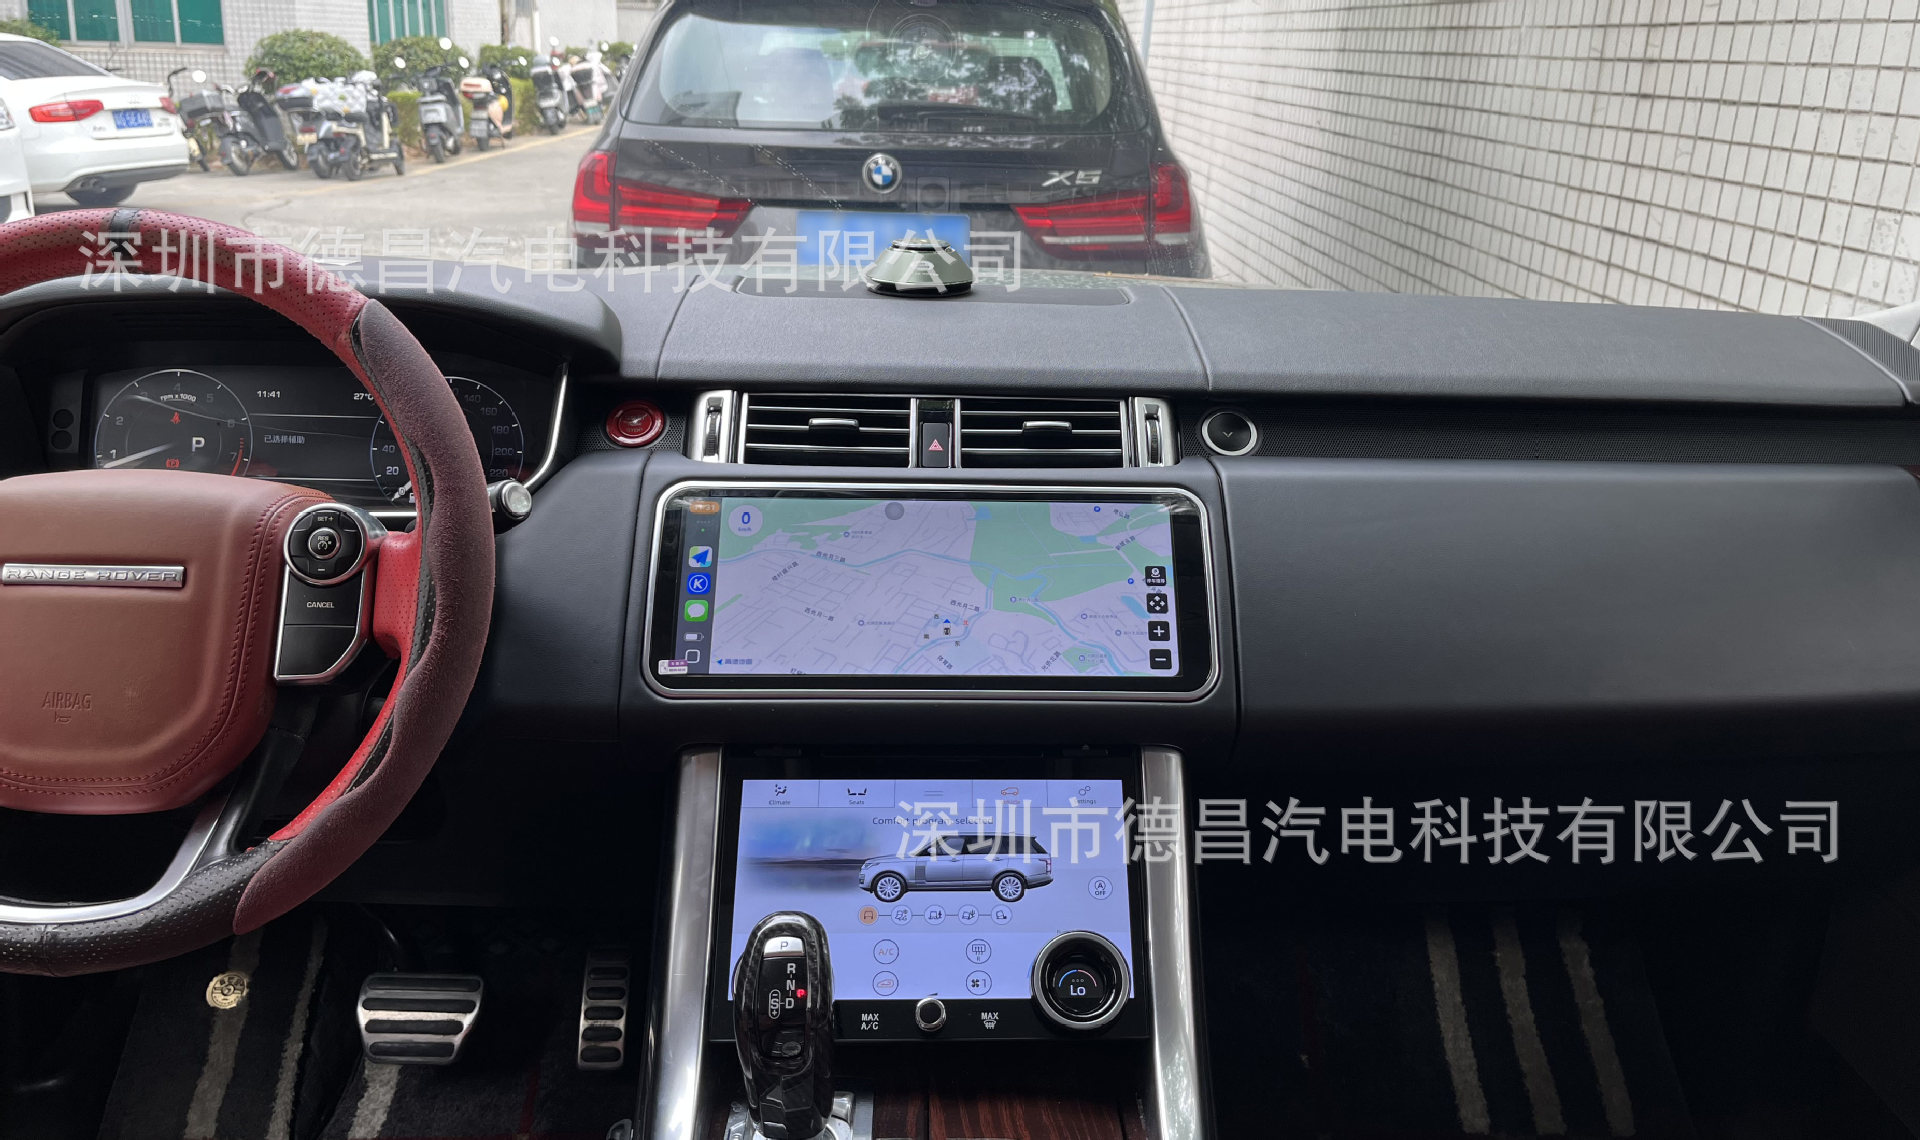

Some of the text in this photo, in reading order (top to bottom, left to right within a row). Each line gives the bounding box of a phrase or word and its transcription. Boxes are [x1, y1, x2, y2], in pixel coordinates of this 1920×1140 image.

[1042, 169, 1102, 187] X5
[173, 382, 181, 392] 4
[160, 394, 174, 402] rpm
[179, 393, 197, 402] 1000
[206, 393, 214, 403] 5
[256, 390, 281, 398] 11:41
[463, 394, 481, 403] 140
[480, 407, 498, 417] 160
[115, 415, 124, 426] 2
[227, 418, 236, 428] 6
[491, 425, 510, 435] 180
[192, 436, 205, 452] P
[382, 444, 396, 454] 40
[109, 449, 117, 459] 1
[229, 451, 238, 462] 7
[494, 447, 514, 457] 200
[386, 466, 399, 476] 20
[489, 468, 509, 478] 220
[741, 511, 751, 525] 0
[6, 567, 178, 583] RANGE ROVER
[306, 601, 335, 609] CANCEL
[41, 691, 92, 711] AIRBAG
[780, 941, 789, 950] P
[878, 947, 895, 956] A/C
[786, 962, 797, 974] R
[786, 979, 796, 991] N
[770, 998, 779, 1010] S
[785, 997, 795, 1009] D
[861, 1013, 880, 1021] MAX
[980, 1011, 999, 1020] MAX
[860, 1021, 879, 1031] A/C
